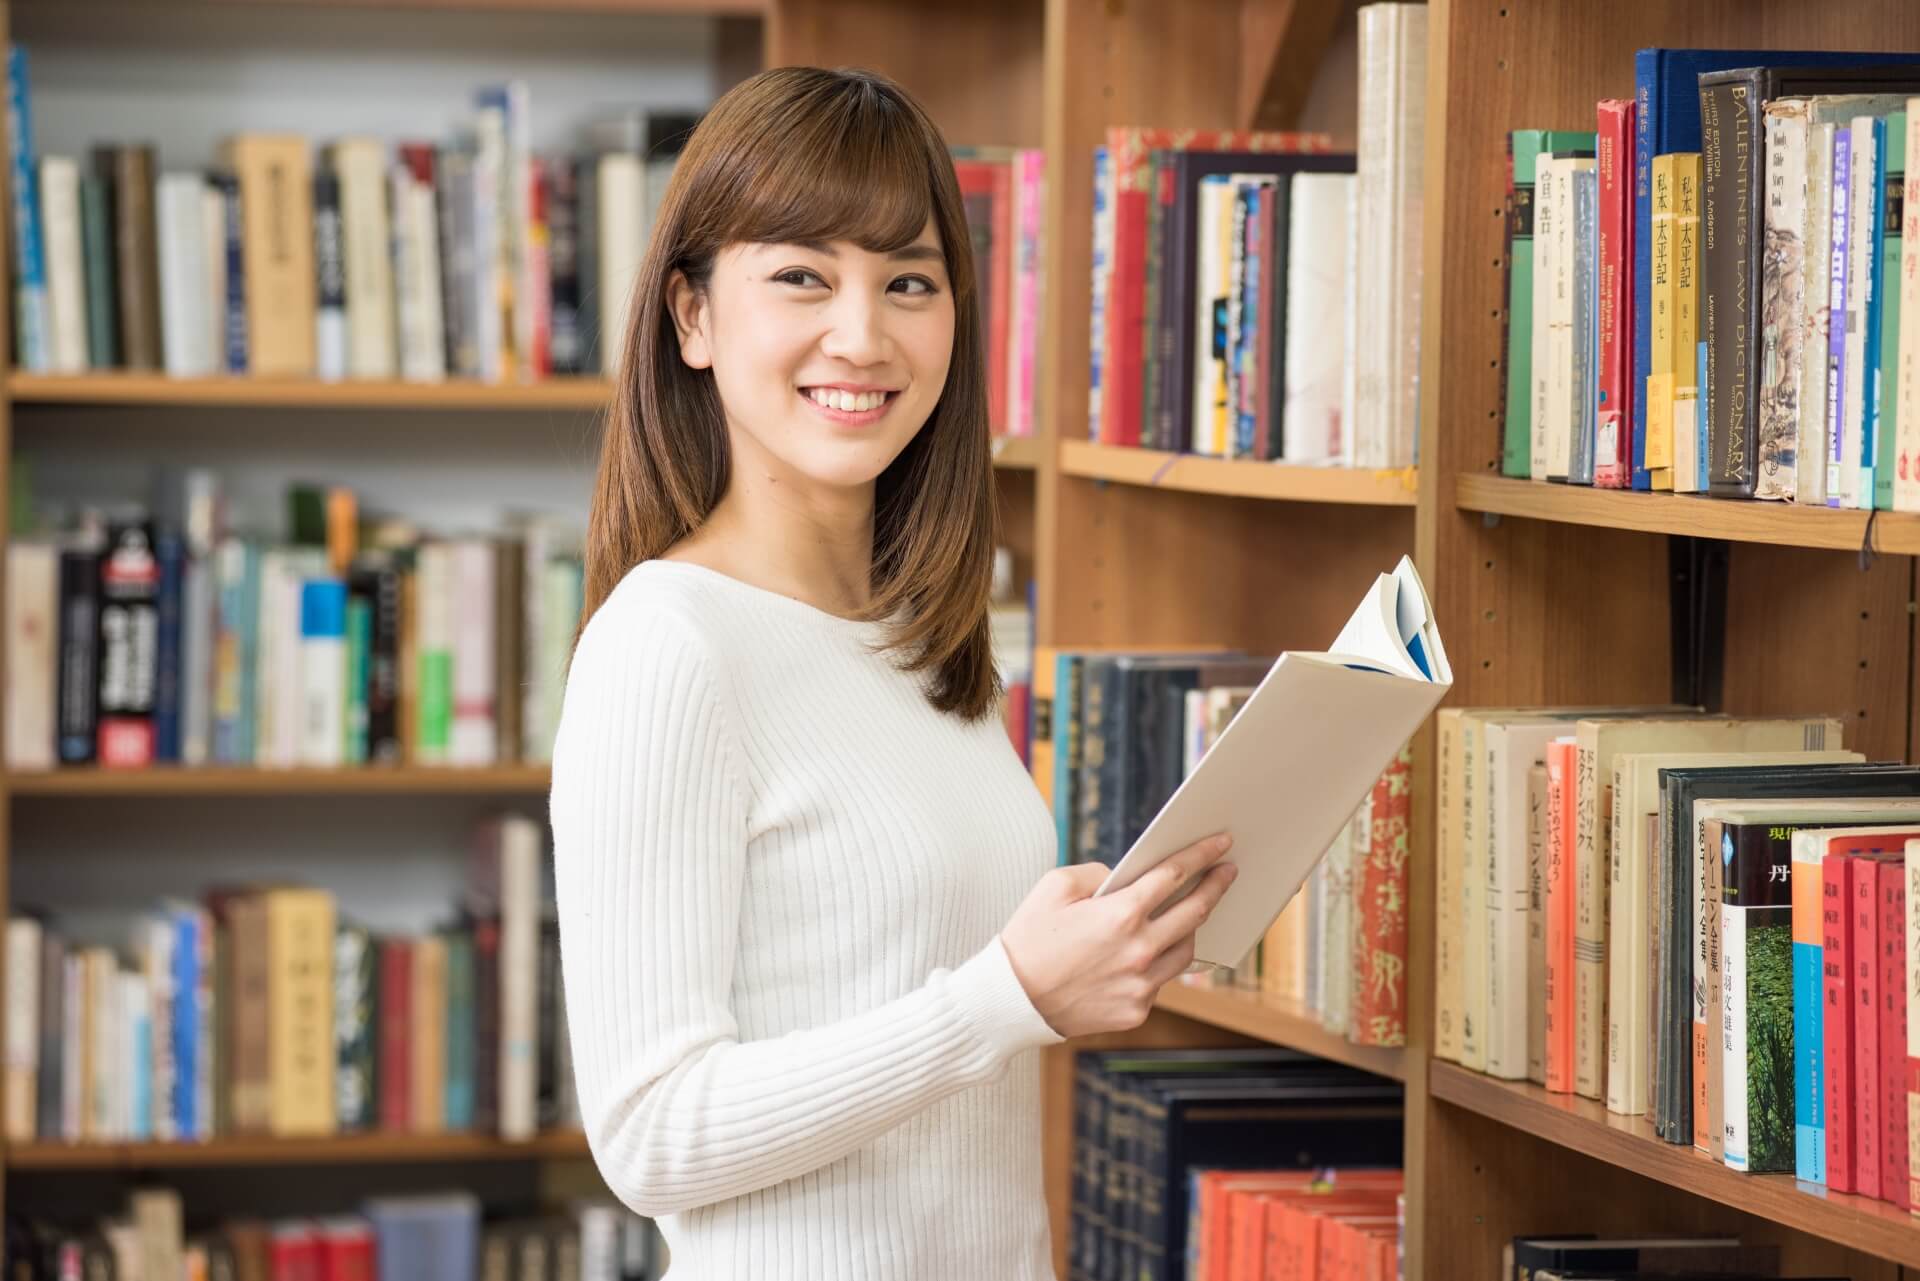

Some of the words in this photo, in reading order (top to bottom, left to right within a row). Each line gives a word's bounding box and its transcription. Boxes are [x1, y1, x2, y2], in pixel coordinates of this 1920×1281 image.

[1708, 90, 1719, 127] THIRD
[1713, 130, 1721, 177] EDITION
[1705, 144, 1713, 182] William
[1732, 86, 1748, 246] BALLENTINE'S
[1679, 176, 1693, 289] 私本太平記
[1707, 199, 1715, 249] Anderson
[1736, 260, 1746, 313] LAW
[1731, 324, 1745, 481] DICTIONARY
[1576, 748, 1586, 849] スタインベック
[1709, 844, 1719, 973] レーニン全集
[1723, 954, 1733, 1052] 丹羽文雄集
